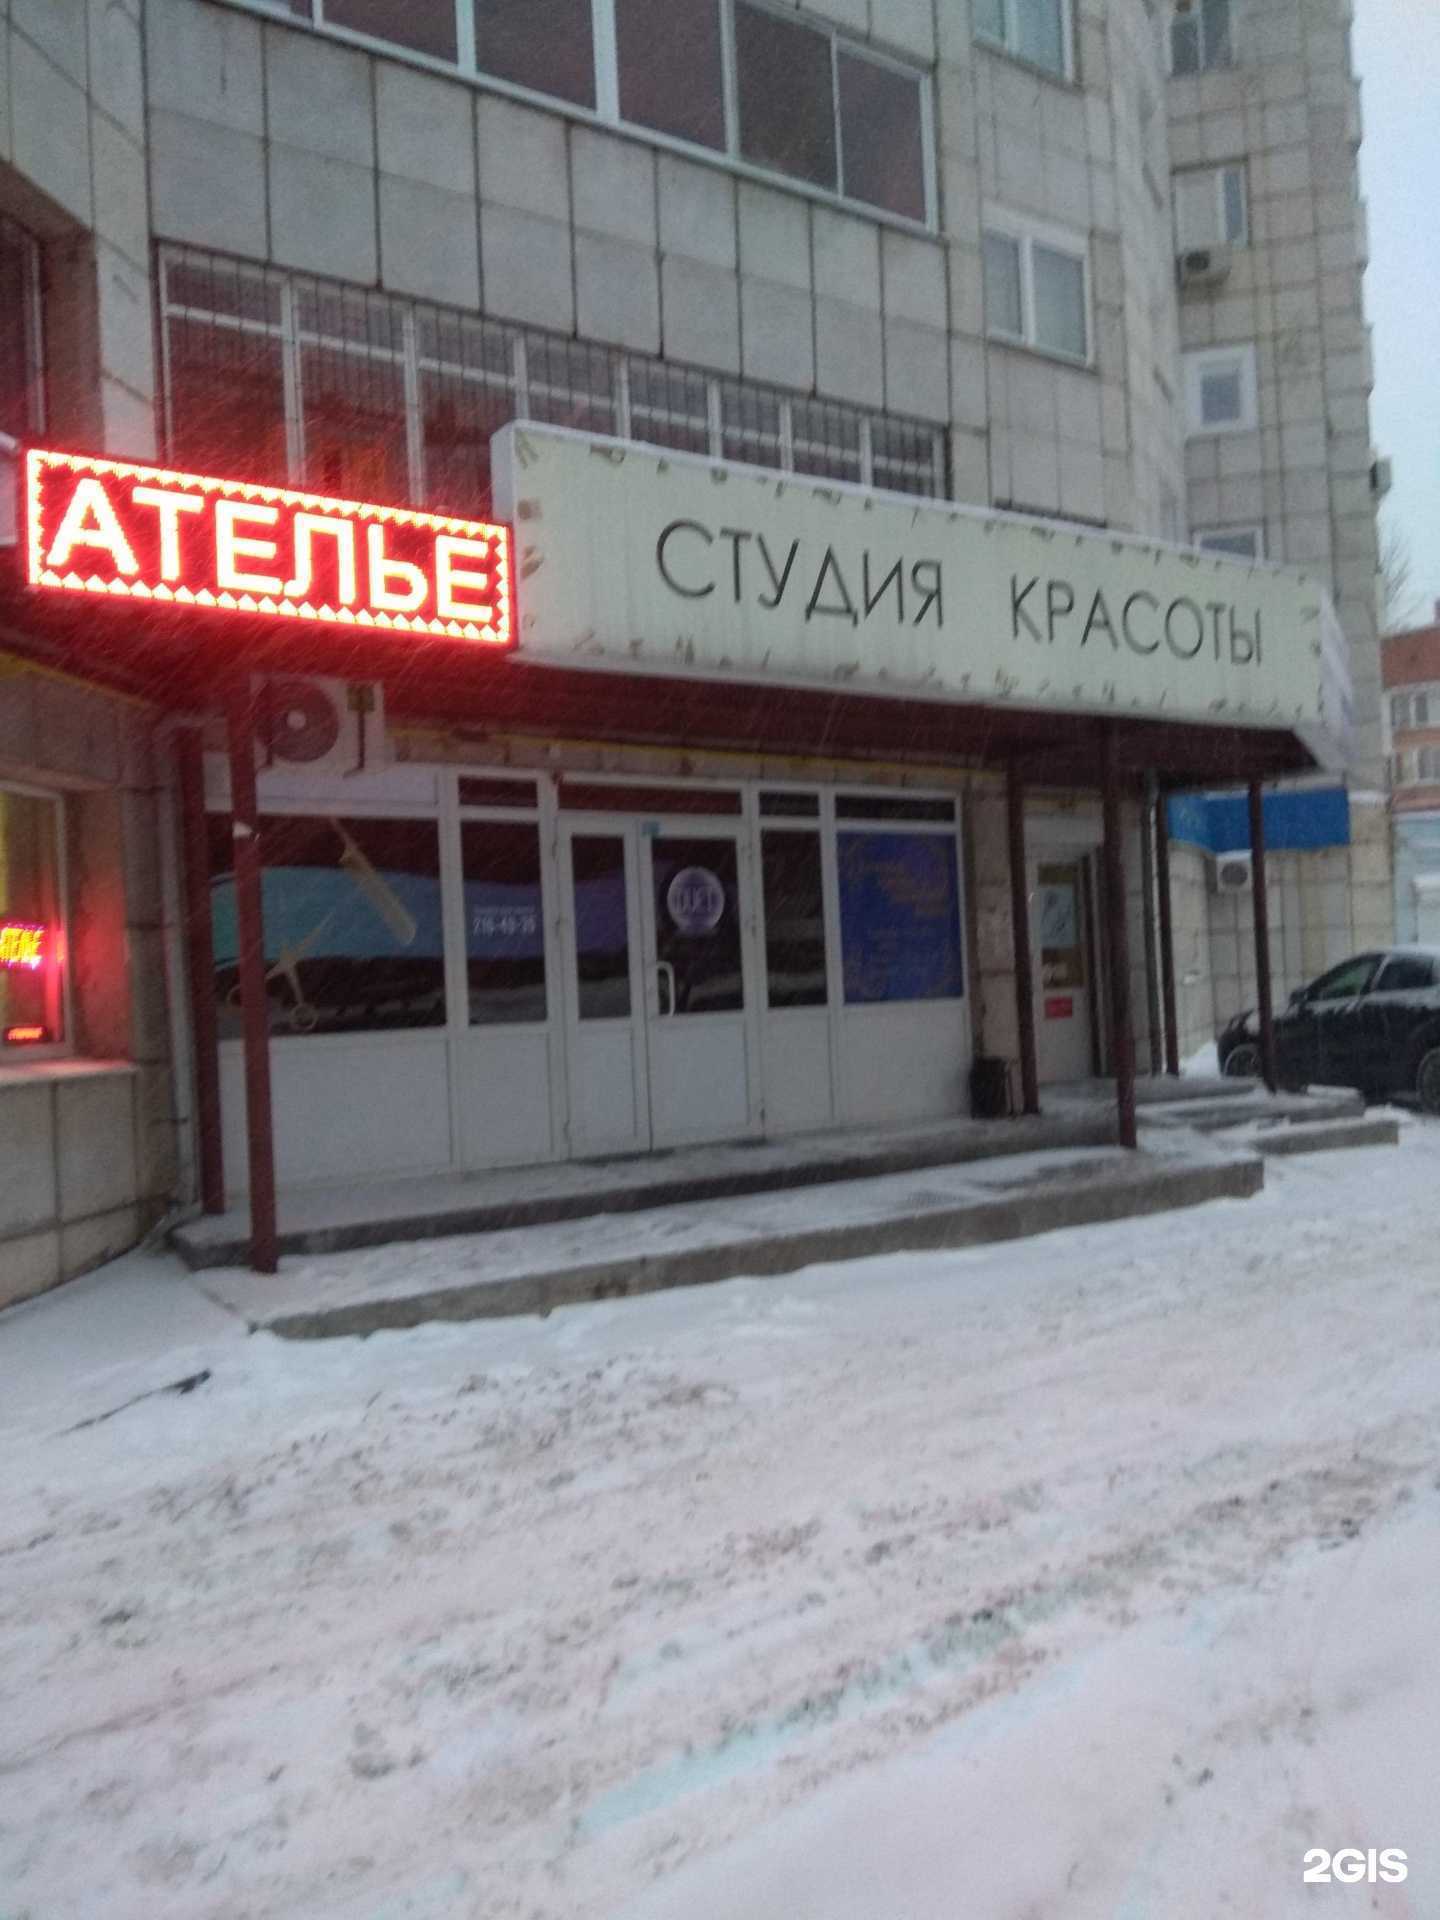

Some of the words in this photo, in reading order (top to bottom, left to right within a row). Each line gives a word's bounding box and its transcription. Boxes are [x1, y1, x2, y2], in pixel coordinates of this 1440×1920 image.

[46, 478, 494, 623] АТЕЛЬЕ
[656, 518, 943, 628] СТУДИЯ
[1010, 574, 1262, 666] КРАСОТЫ
